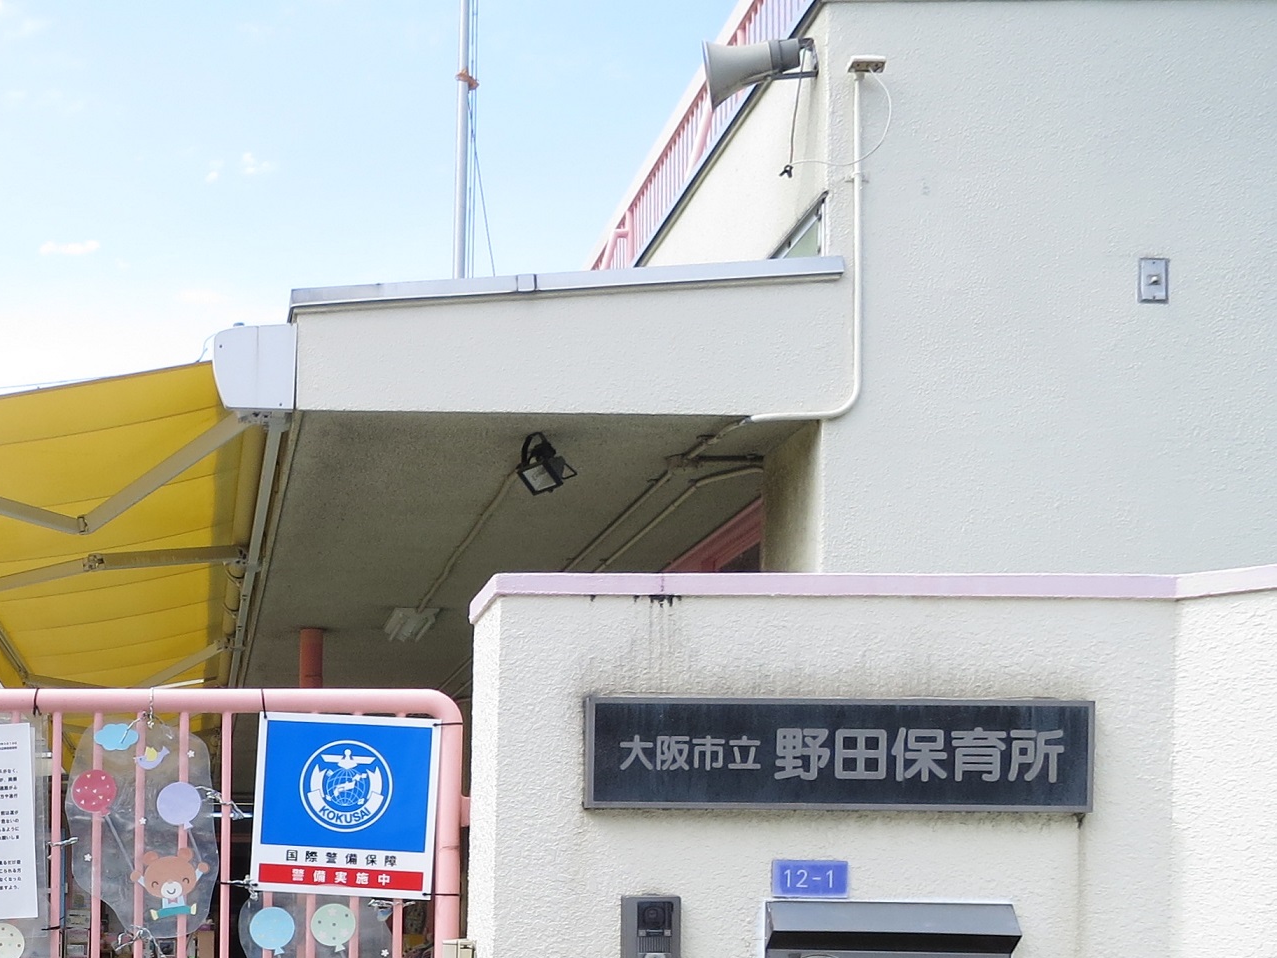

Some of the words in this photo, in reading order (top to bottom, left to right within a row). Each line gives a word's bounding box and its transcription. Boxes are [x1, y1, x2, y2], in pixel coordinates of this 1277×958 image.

[619, 732, 762, 772] 大阪市立
[773, 727, 1066, 783] 野田保育所
[318, 805, 371, 824] KOKUSAI
[286, 849, 397, 867] 国際警備保障
[291, 868, 391, 885] 警備実施中
[783, 869, 835, 888] 12-1
